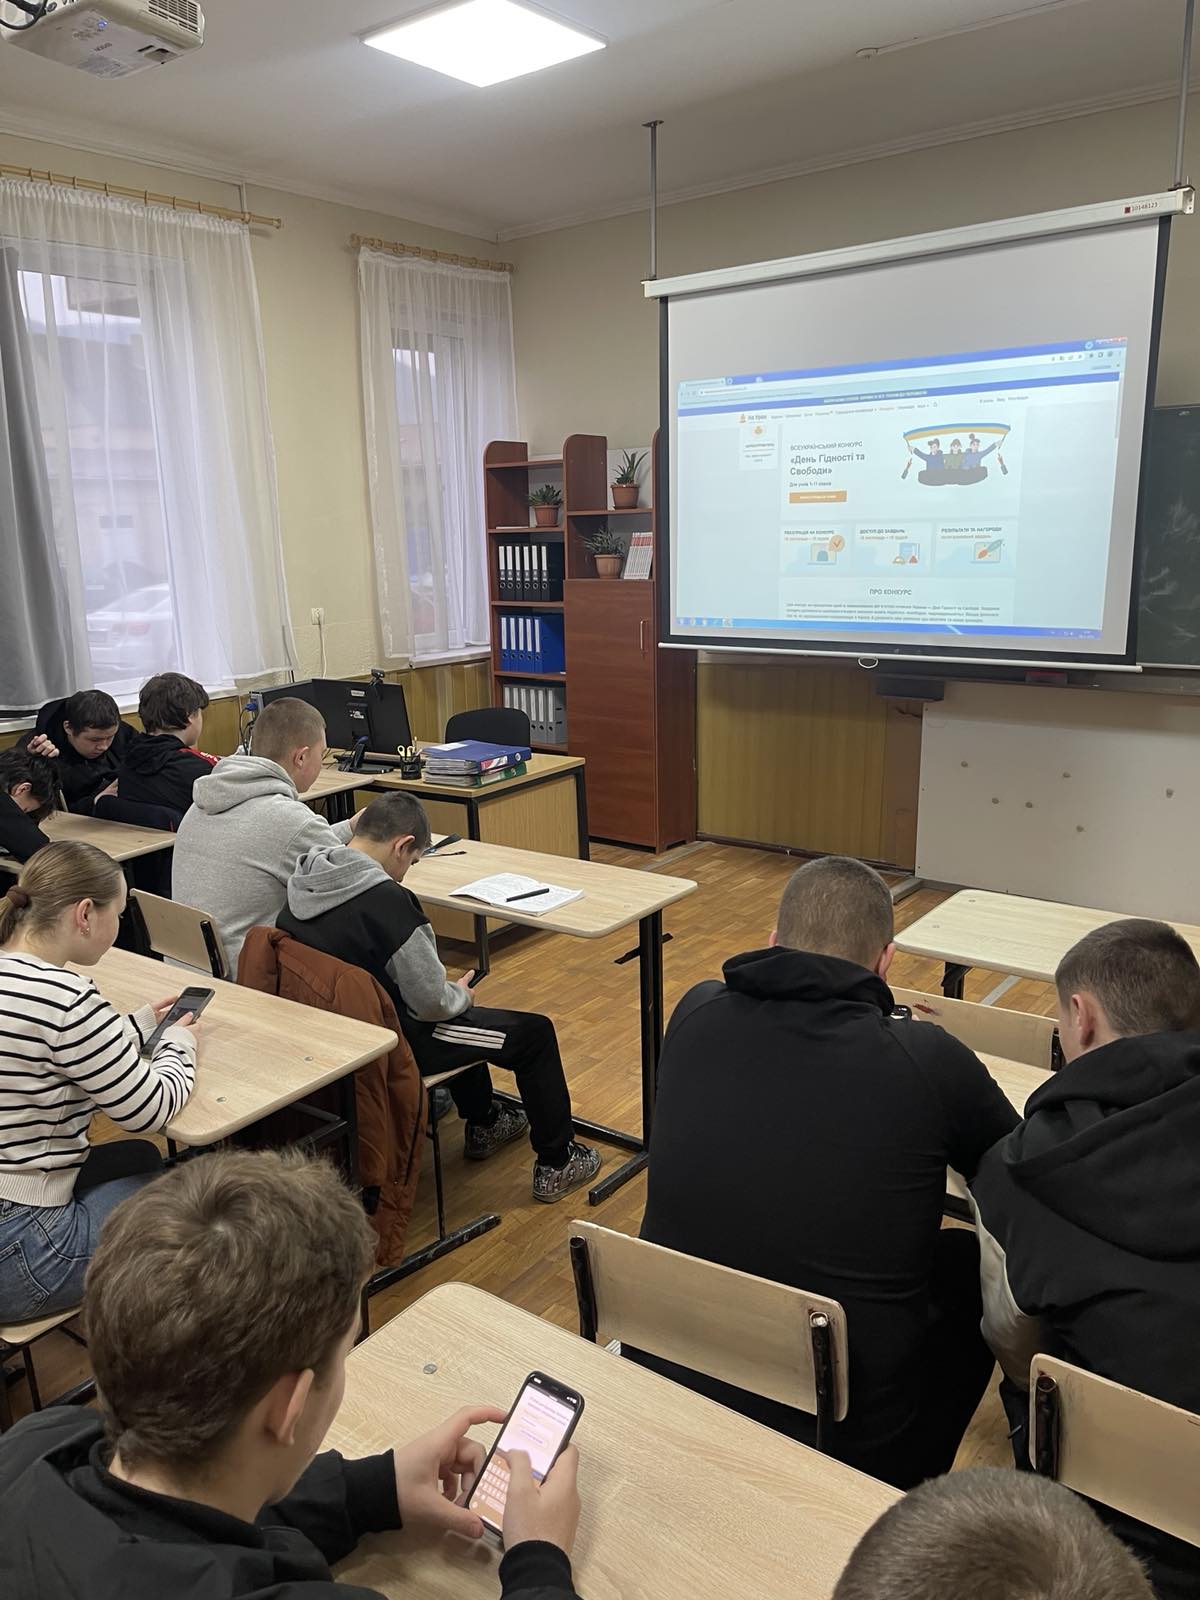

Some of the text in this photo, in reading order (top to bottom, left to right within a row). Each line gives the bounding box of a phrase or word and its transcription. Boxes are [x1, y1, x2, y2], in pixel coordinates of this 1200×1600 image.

[838, 441, 863, 449] КОНКУРС
[790, 455, 817, 464] «День
[819, 452, 854, 463] Гідності
[790, 466, 833, 476] Свободи»
